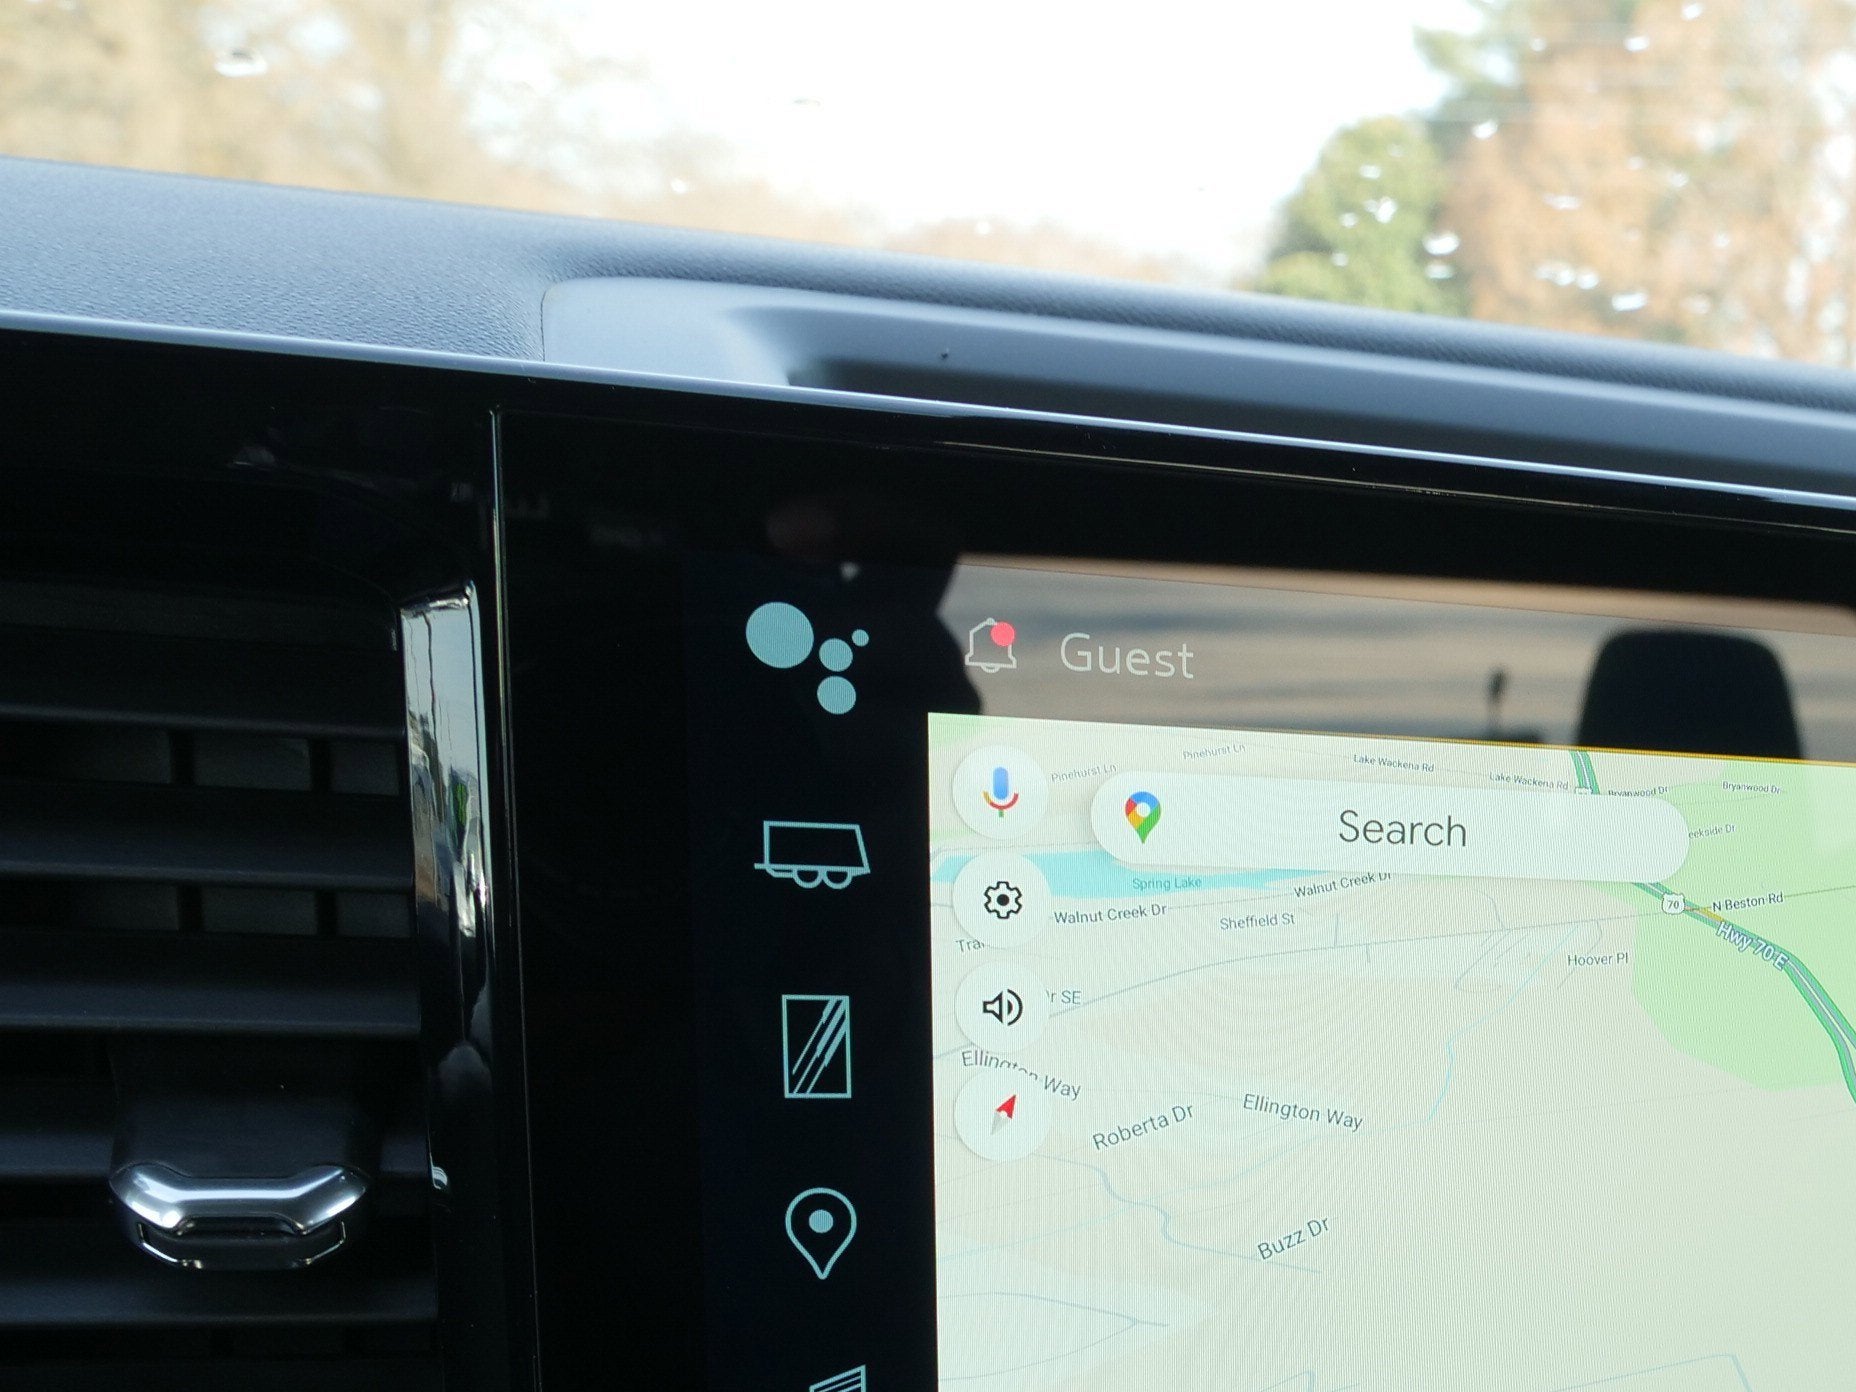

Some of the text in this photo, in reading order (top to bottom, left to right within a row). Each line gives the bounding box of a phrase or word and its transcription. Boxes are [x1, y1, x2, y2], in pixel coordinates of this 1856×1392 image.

[1060, 633, 1195, 680] Guest
[1353, 754, 1376, 766] Lake
[1422, 762, 1435, 773] Rd
[1051, 765, 1102, 784] Pinehurst
[1489, 771, 1511, 783] Lake
[1556, 780, 1569, 790] Rd
[1658, 785, 1669, 794] Dr
[1771, 784, 1781, 795] Dr
[1338, 808, 1468, 848] Search
[1688, 825, 1723, 839] eekside
[1132, 876, 1203, 892] Spring Lake
[1293, 880, 1338, 898] Walnut
[1340, 871, 1376, 889] Creek
[1712, 891, 1784, 912] N Beston Rd
[1053, 903, 1168, 926] Walnut Creek Dr
[1219, 913, 1296, 931] Sheffield St
[1716, 921, 1788, 971] Hwy 70 E
[1567, 952, 1629, 966] Hoover Pl
[1061, 989, 1082, 1005] SE
[1044, 1074, 1081, 1102] Way
[1243, 1093, 1363, 1133] Ellington Way
[1092, 1104, 1195, 1150] Roberta Dr
[1257, 1217, 1329, 1260] Buzz Dr
